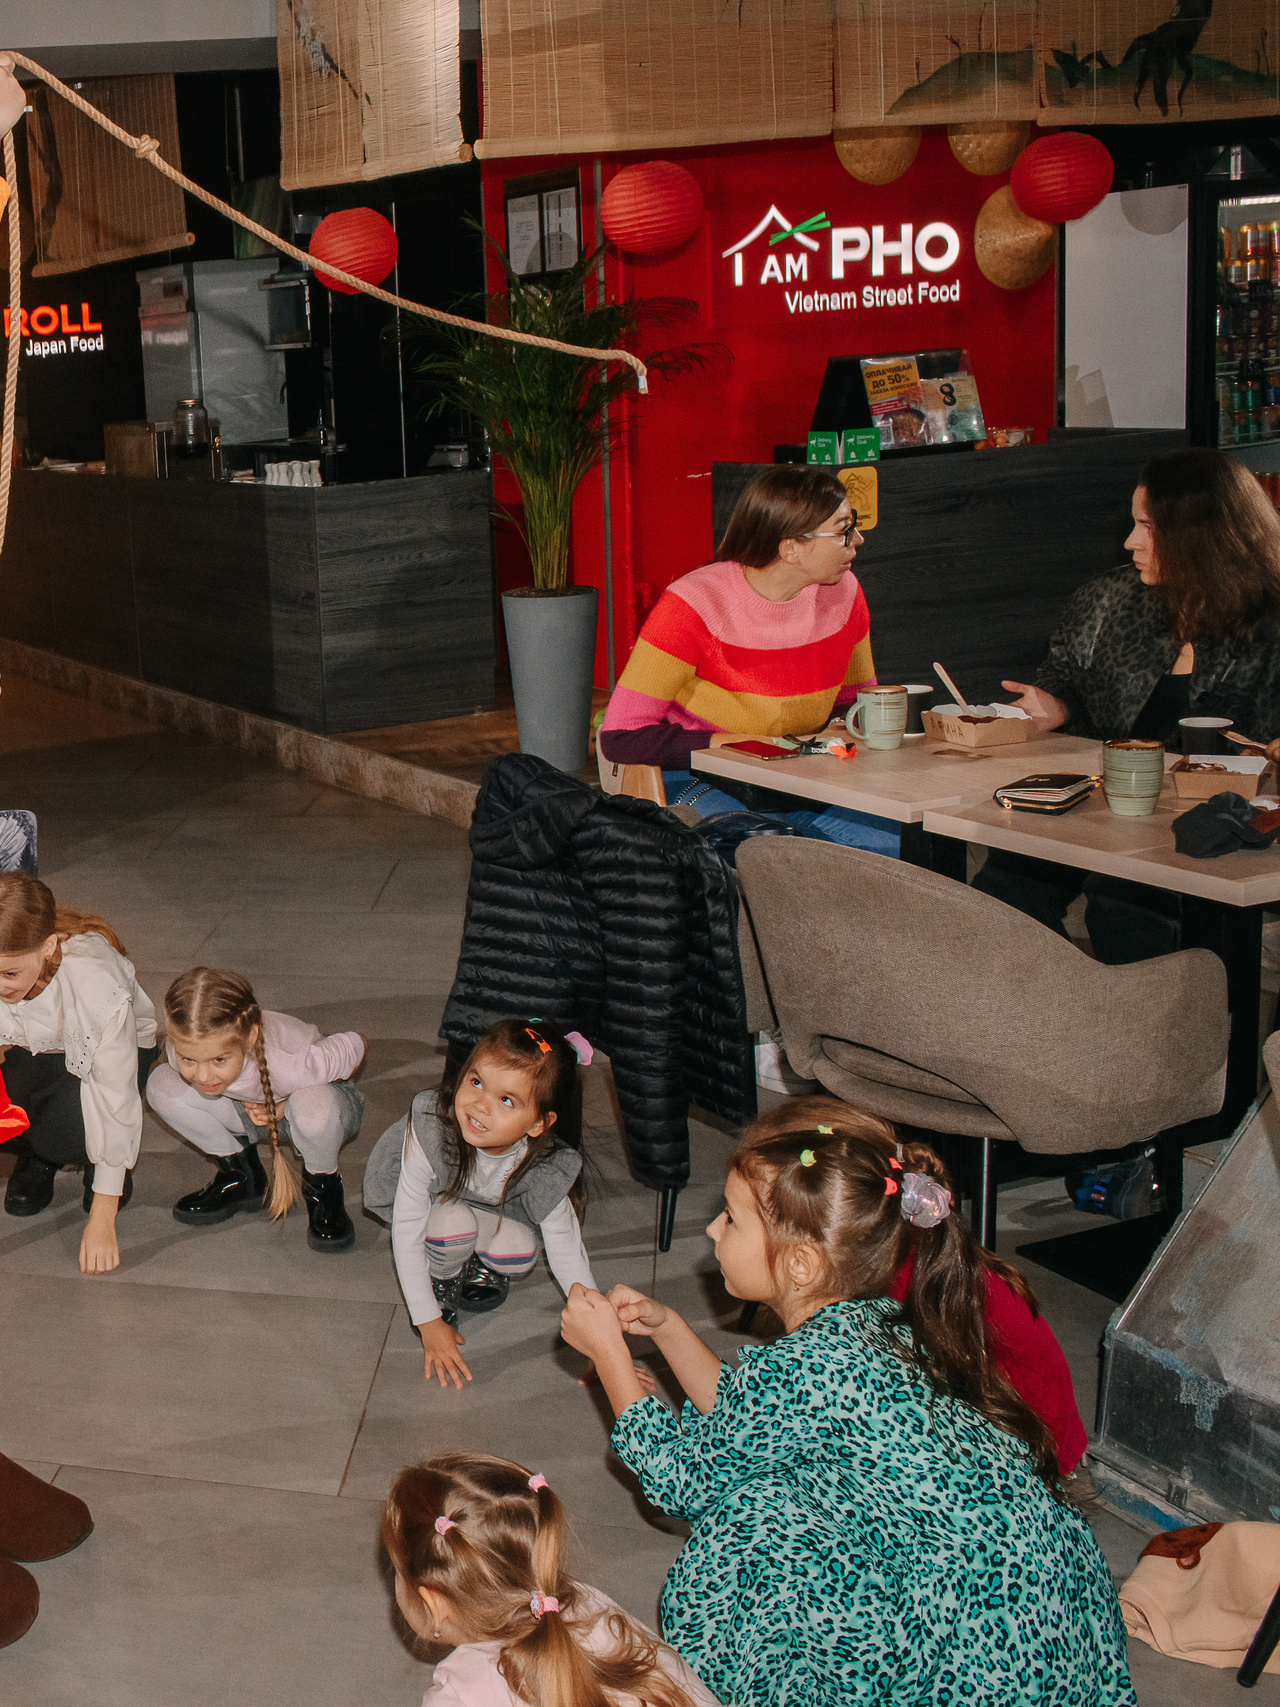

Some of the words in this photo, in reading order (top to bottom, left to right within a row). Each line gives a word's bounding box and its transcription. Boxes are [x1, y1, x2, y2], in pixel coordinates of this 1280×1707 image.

[734, 253, 743, 286] I
[760, 252, 808, 285] AM
[831, 222, 960, 280] PHO
[784, 290, 857, 314] Vietnam
[862, 284, 913, 308] Street
[918, 279, 960, 304] Food
[3, 302, 102, 338] ROLL
[25, 339, 67, 358] Japan
[70, 334, 104, 352] Food
[865, 363, 913, 379] ОПЛАЧИВАЙ
[887, 373, 910, 385] 50%
